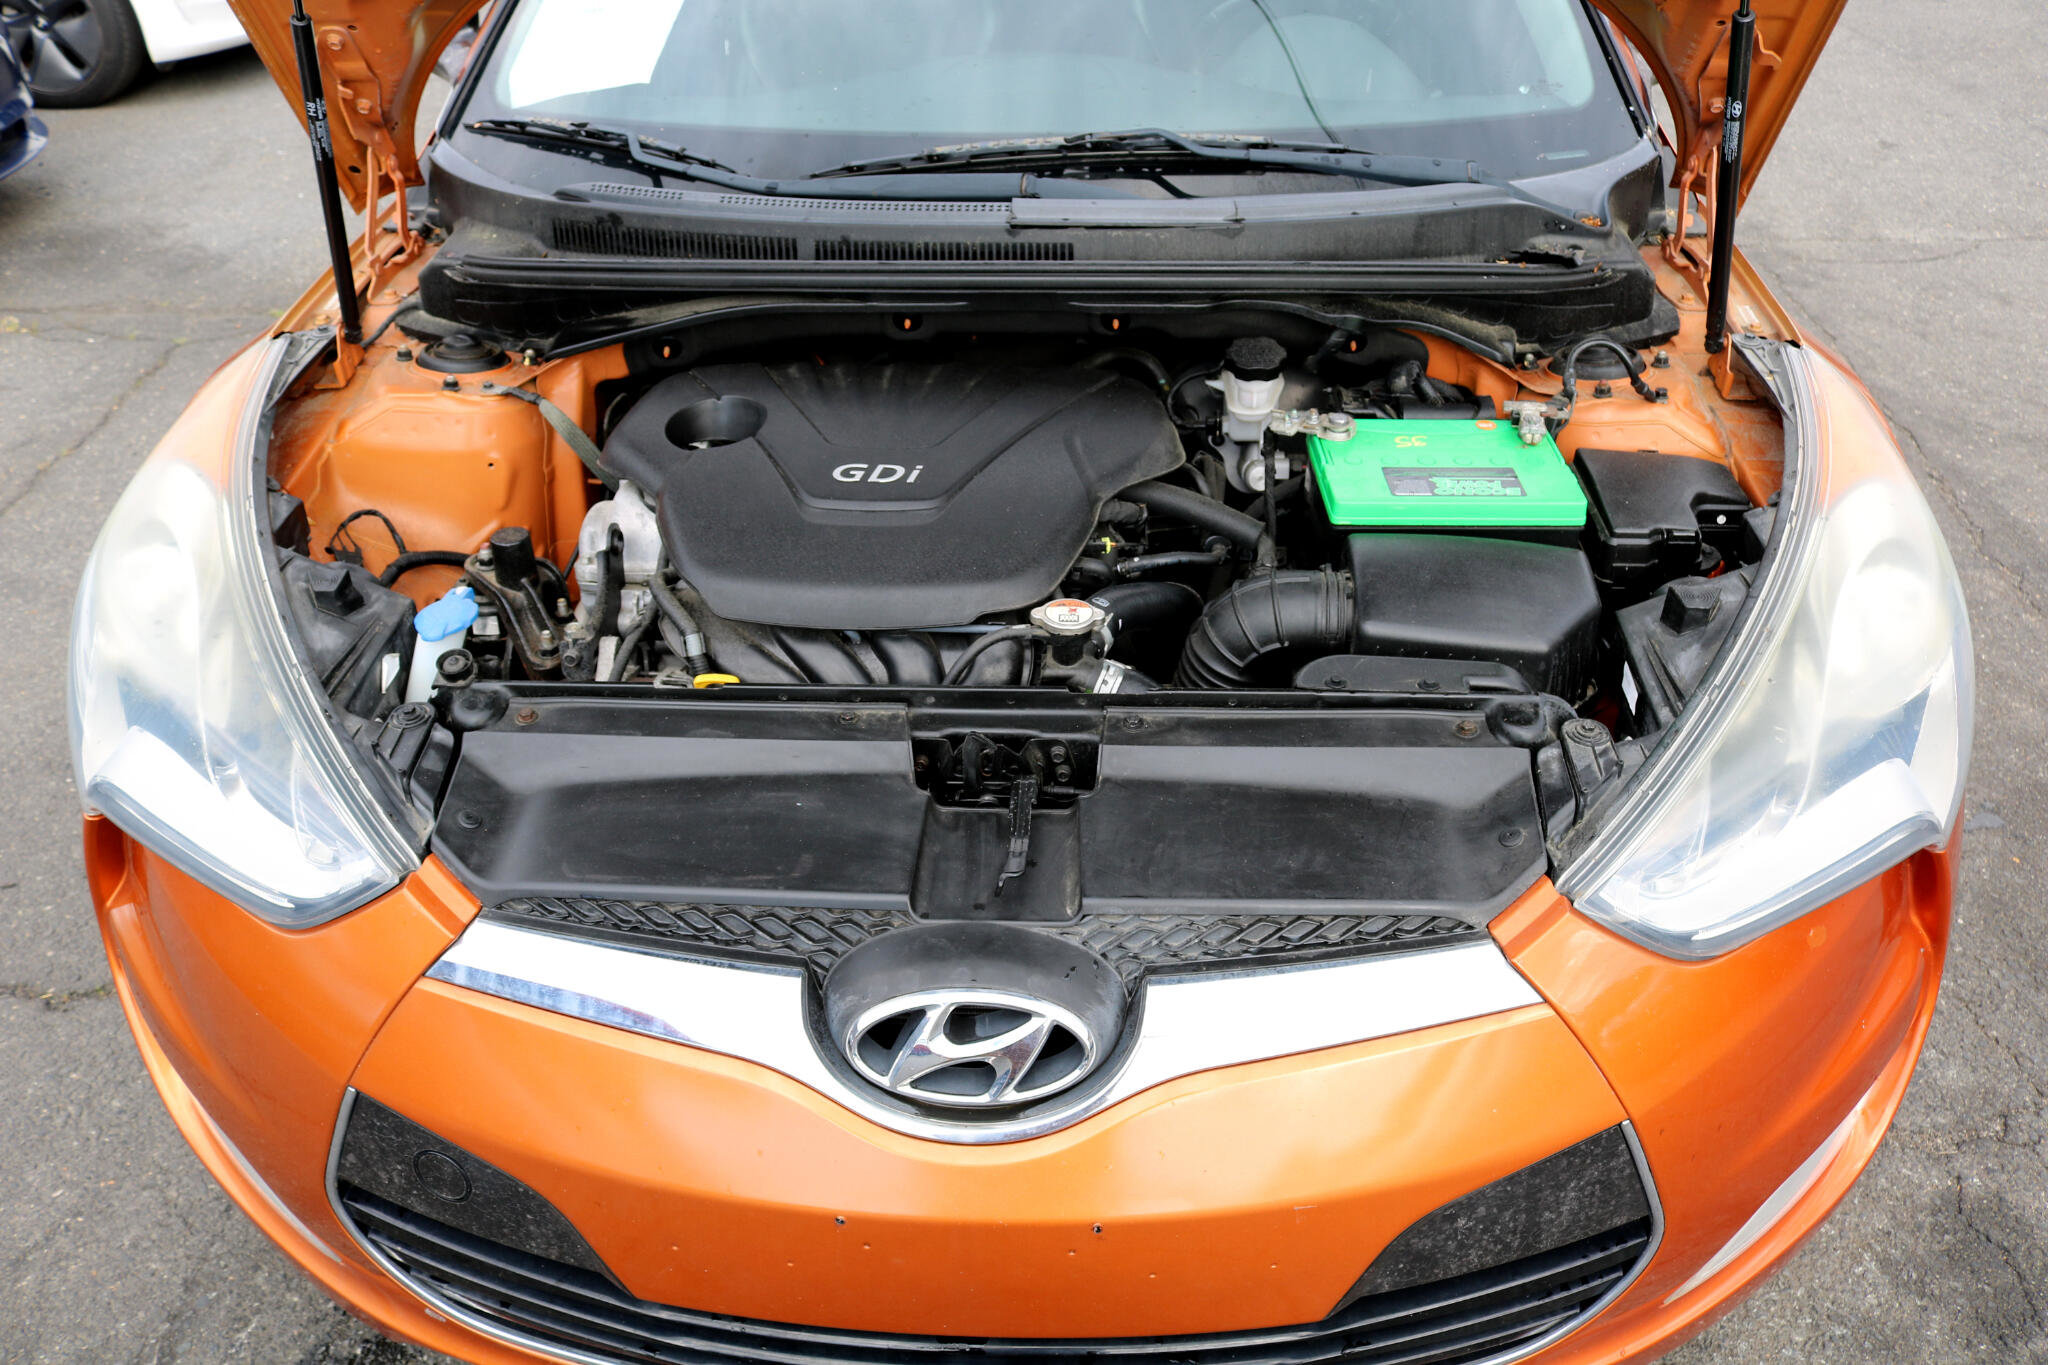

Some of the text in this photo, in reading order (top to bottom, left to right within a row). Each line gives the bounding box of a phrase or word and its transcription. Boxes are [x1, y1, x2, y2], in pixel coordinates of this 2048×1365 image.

[306, 101, 317, 116] RH
[1394, 435, 1428, 448] 35
[832, 463, 924, 483] GDi
